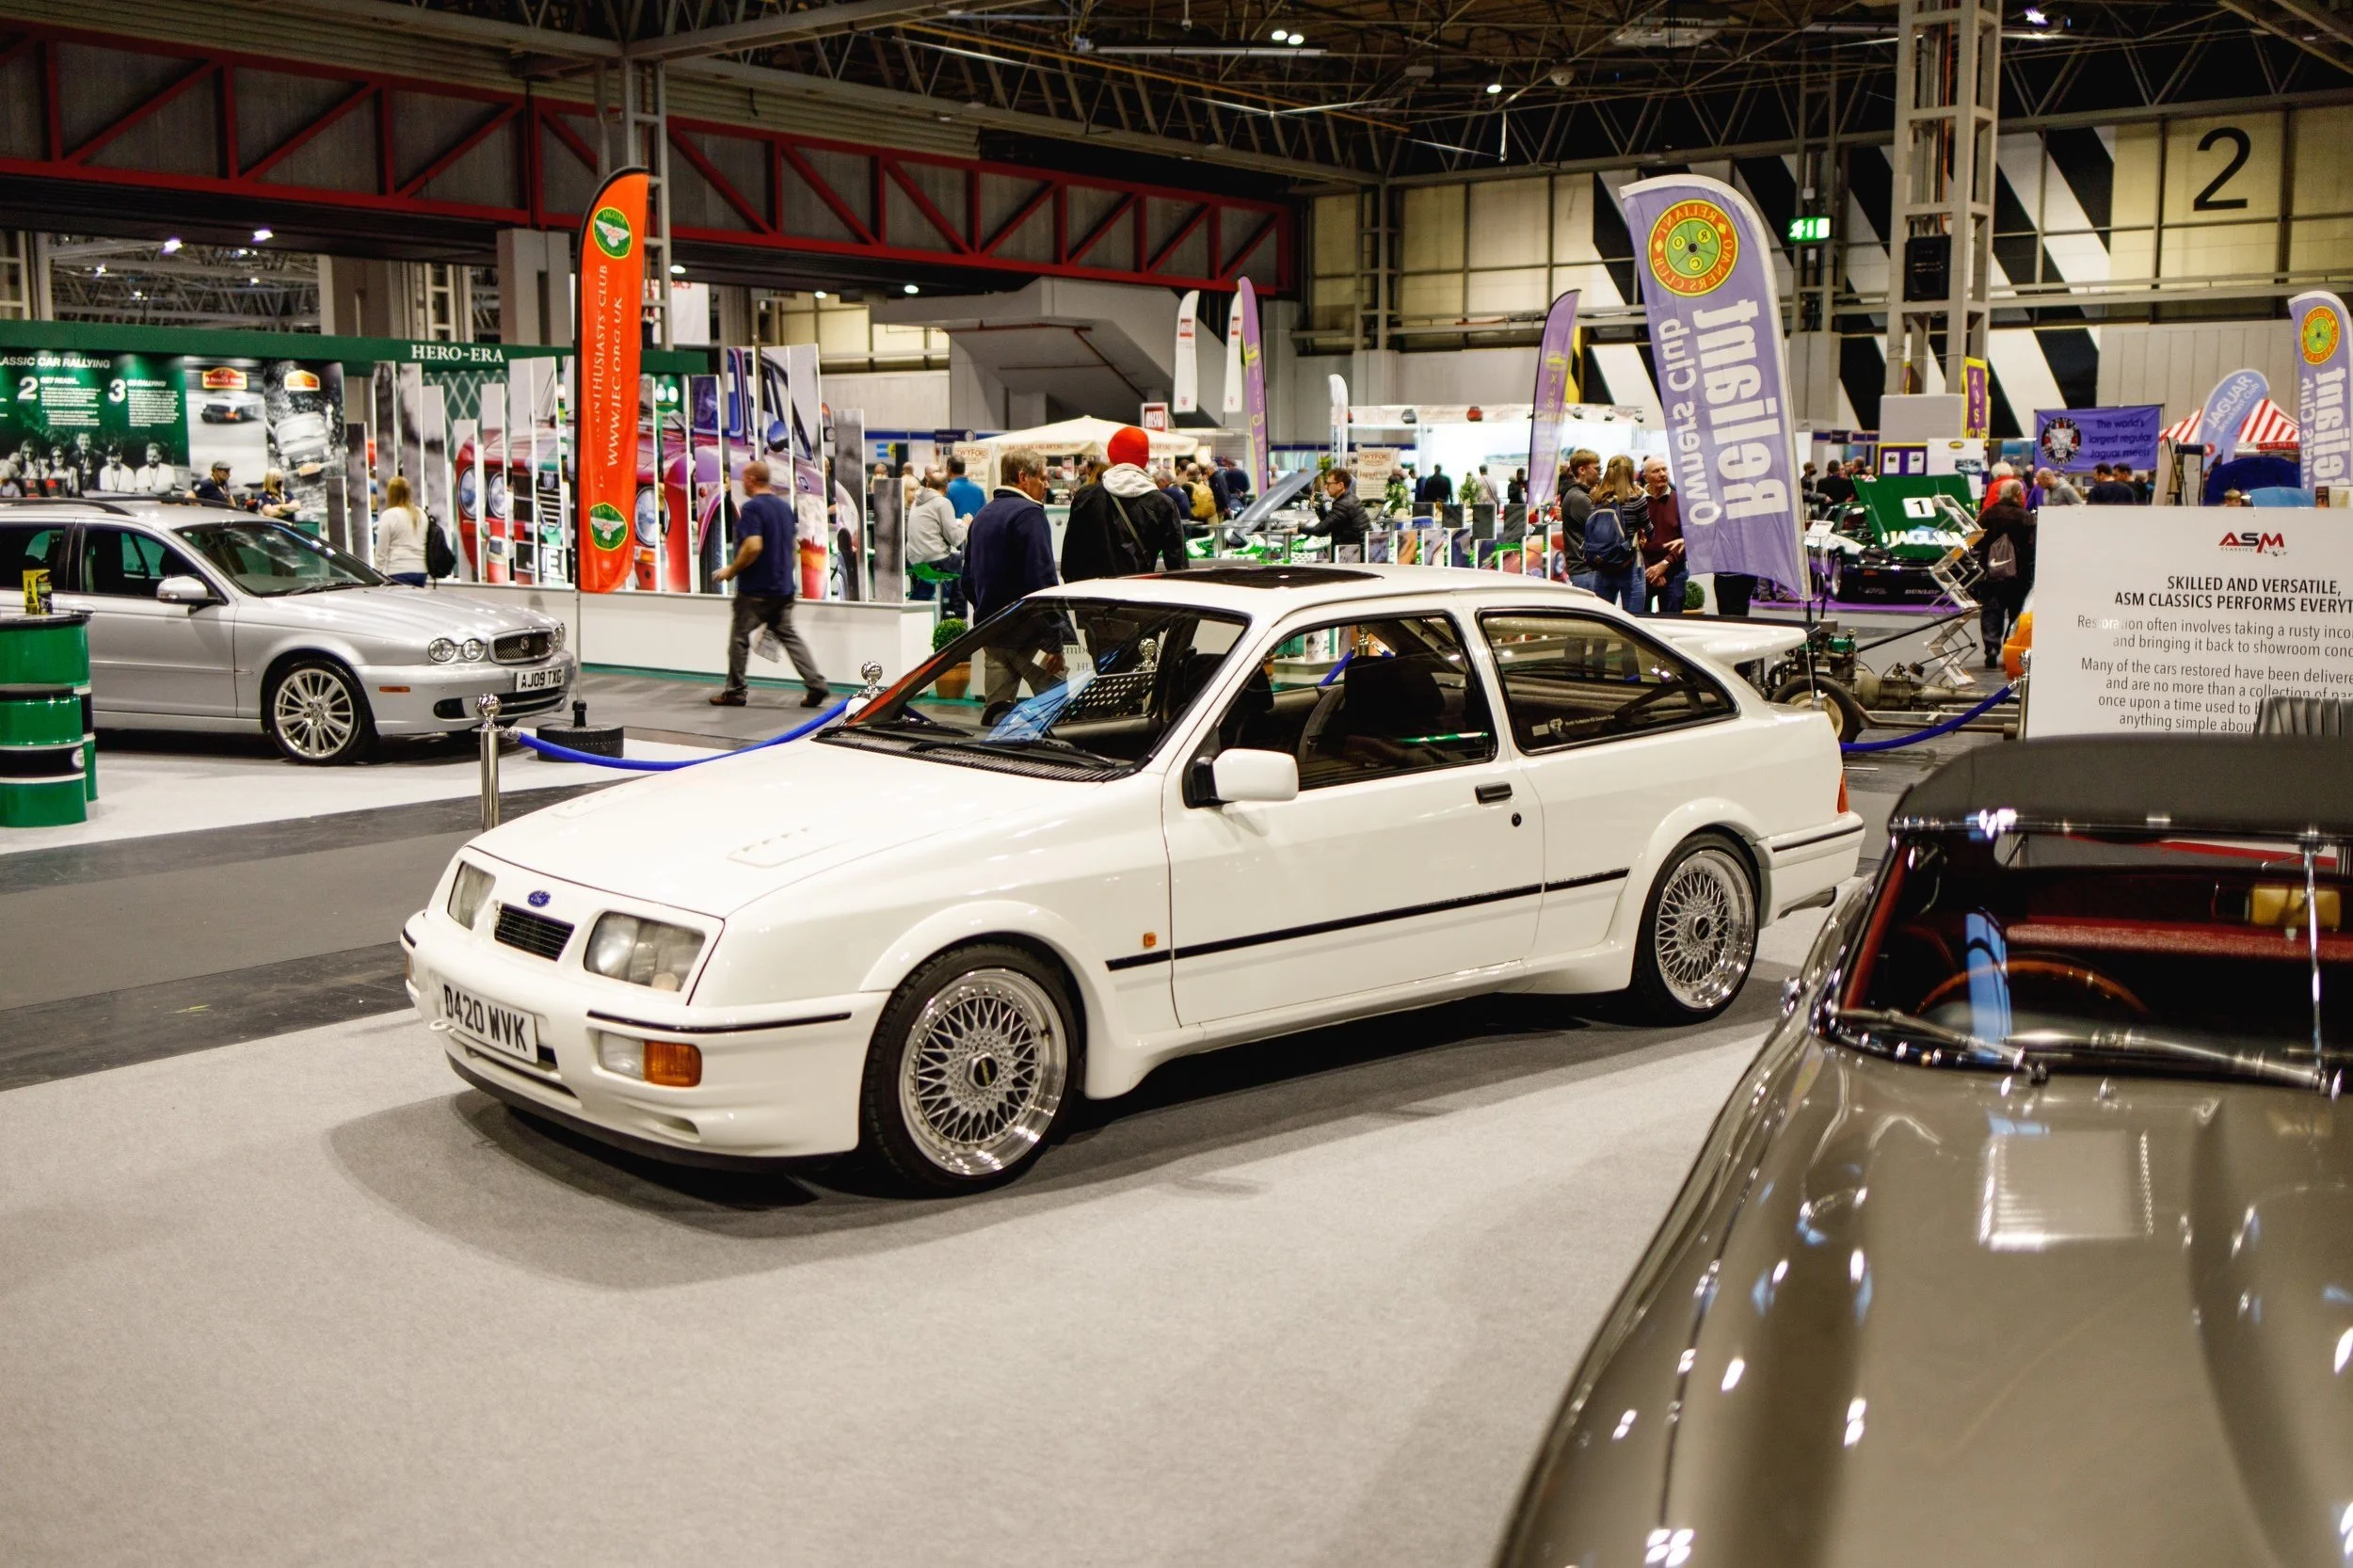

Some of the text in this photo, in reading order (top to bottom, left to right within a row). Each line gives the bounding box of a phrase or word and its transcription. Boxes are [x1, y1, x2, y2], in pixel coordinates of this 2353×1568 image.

[2193, 127, 2251, 212] 2
[598, 264, 609, 307] CLUB
[0, 356, 111, 368] ASSIC CAR RALLYING
[411, 344, 504, 363] HERO-ERA
[18, 376, 38, 400] 2
[108, 378, 126, 403] 3
[607, 296, 622, 467] WWW.JEC.ORG.UK
[2205, 376, 2253, 428] JAGUAR
[2096, 420, 2112, 429] The
[2089, 432, 2153, 446] largest regular
[2089, 450, 2121, 460] Jaguar
[1913, 500, 1926, 515] 1
[2218, 532, 2284, 553] ASM
[2167, 575, 2341, 597] SKILLED AND VERSATILE,
[2115, 592, 2144, 606] ASM
[2149, 593, 2212, 609] CLASSICS
[2217, 595, 2296, 612] PERFORMS
[2147, 617, 2177, 632] often
[2181, 619, 2231, 634] involves
[2235, 621, 2273, 639] taking
[2278, 626, 2284, 636] a
[2289, 625, 2320, 641] rusty
[2113, 634, 2136, 648] and
[2138, 634, 2190, 653] bringing
[2195, 638, 2202, 650] it
[2206, 637, 2233, 652] back
[2238, 640, 2249, 652] to
[2253, 640, 2320, 656] showroom
[521, 669, 562, 688] AJ09 TXG
[2081, 657, 2113, 675] Many
[2117, 659, 2128, 672] of
[2132, 660, 2151, 674] the
[2154, 664, 2177, 676] cars
[2181, 664, 2231, 678] restored
[2234, 664, 2264, 679] have
[2268, 666, 2299, 681] been
[2105, 677, 2128, 689] and
[2132, 680, 2150, 691] are
[2153, 681, 2169, 692] no
[2172, 682, 2203, 695] more
[2208, 681, 2234, 696] than
[2239, 686, 2246, 696] a
[2249, 684, 2311, 697] collection
[2099, 696, 2126, 707] once
[2130, 698, 2160, 712] upon
[2164, 699, 2170, 710] a
[2174, 698, 2201, 712] time
[2206, 700, 2234, 714] used
[2239, 703, 2250, 715] to
[2120, 712, 2172, 731] anything
[2176, 716, 2217, 734] simple
[444, 984, 527, 1052] D420 WVK
